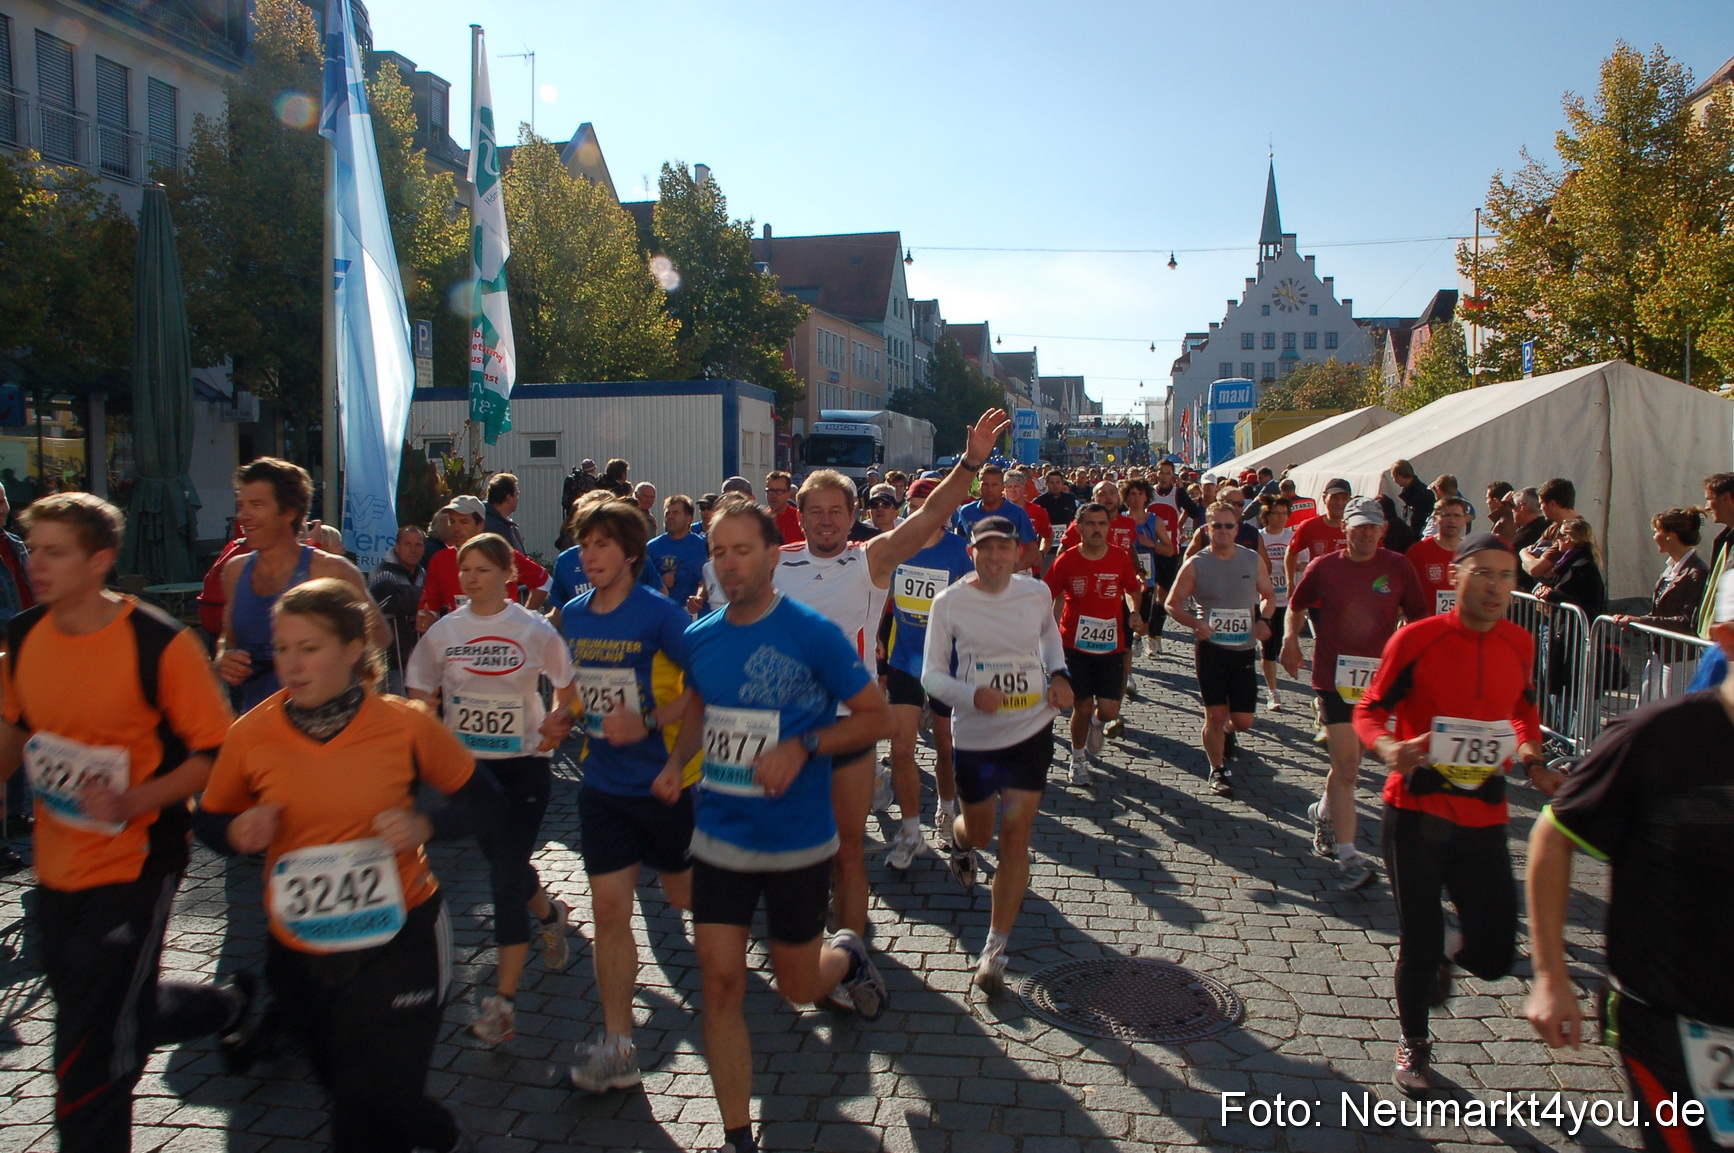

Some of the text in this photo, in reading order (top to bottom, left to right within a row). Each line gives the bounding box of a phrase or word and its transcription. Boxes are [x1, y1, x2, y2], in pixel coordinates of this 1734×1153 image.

[419, 325, 428, 351] P
[1525, 346, 1531, 369] P
[1218, 387, 1250, 404] maxi
[353, 531, 396, 552] ers
[574, 582, 593, 595] HU
[904, 578, 936, 599] 976
[1268, 575, 1286, 587] 30
[1441, 599, 1455, 612] 25
[1081, 626, 1115, 642] 2449
[1214, 618, 1248, 632] 2464
[445, 645, 511, 657] GERHART
[1086, 641, 1107, 650] Xaver
[472, 656, 518, 667] JANIG
[989, 671, 1029, 694] 495
[579, 686, 626, 714] 3251
[458, 708, 515, 734] 2362
[464, 733, 510, 749] Tamara
[706, 727, 768, 764] 2877
[1450, 737, 1501, 764] 783
[283, 863, 389, 917] 3242
[1706, 1044, 1734, 1090] 2
